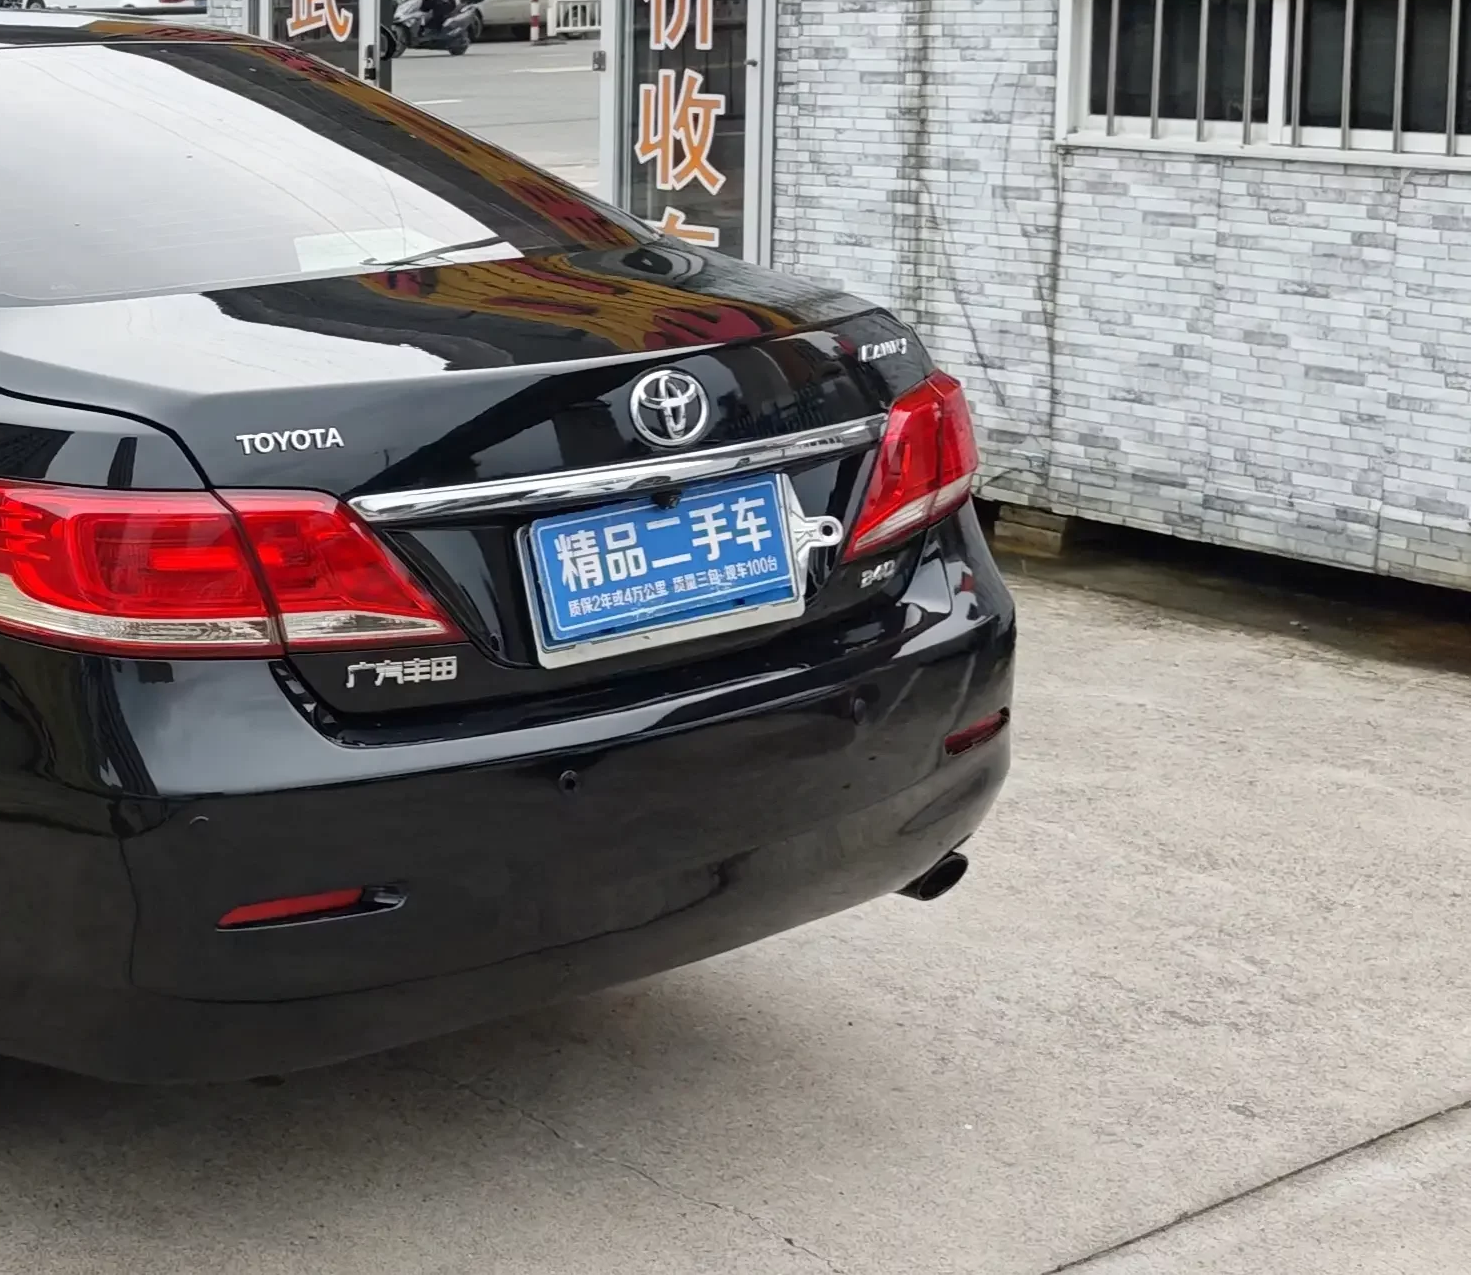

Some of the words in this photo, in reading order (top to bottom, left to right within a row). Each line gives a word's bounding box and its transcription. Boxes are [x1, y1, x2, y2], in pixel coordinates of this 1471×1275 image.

[235, 427, 345, 455] TOYOTA
[554, 496, 772, 591] 精品二手车
[860, 559, 896, 589] 240
[568, 580, 668, 618] 质保2年或4万公里
[346, 656, 458, 688] 广汽丰田
